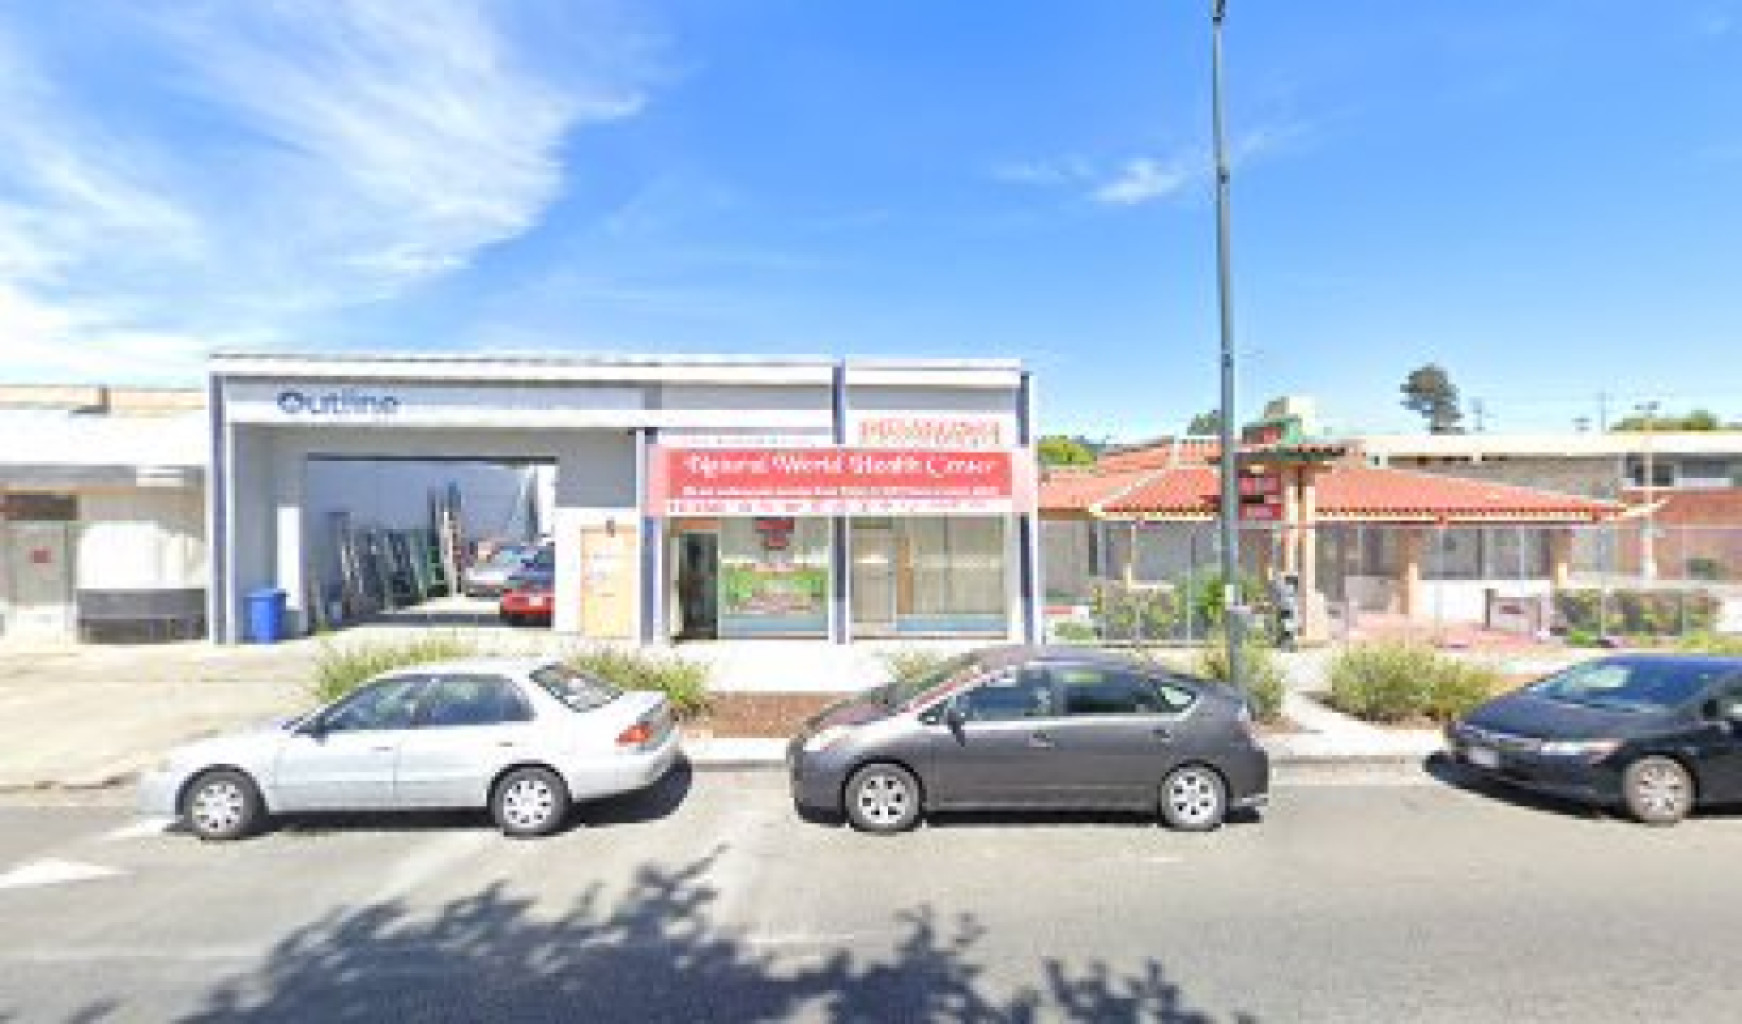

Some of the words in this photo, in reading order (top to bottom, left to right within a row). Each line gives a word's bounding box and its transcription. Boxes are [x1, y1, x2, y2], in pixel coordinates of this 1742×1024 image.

[277, 391, 399, 413] Outline
[772, 455, 842, 474] World
[848, 455, 922, 474] Health
